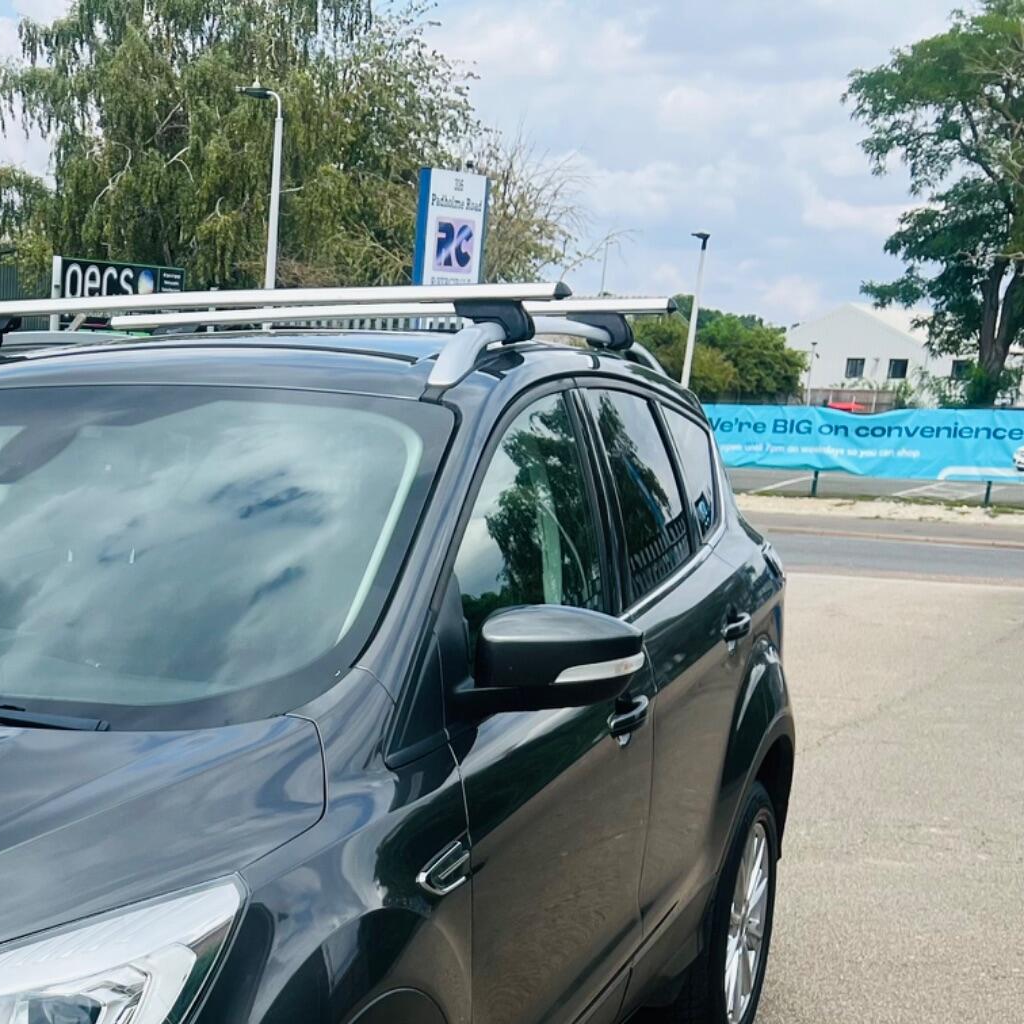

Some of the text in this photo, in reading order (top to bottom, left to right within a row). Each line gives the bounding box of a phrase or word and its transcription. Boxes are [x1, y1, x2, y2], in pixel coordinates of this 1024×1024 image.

[772, 418, 813, 435] BIG
[818, 424, 849, 437] on
[854, 421, 1024, 440] convenience
